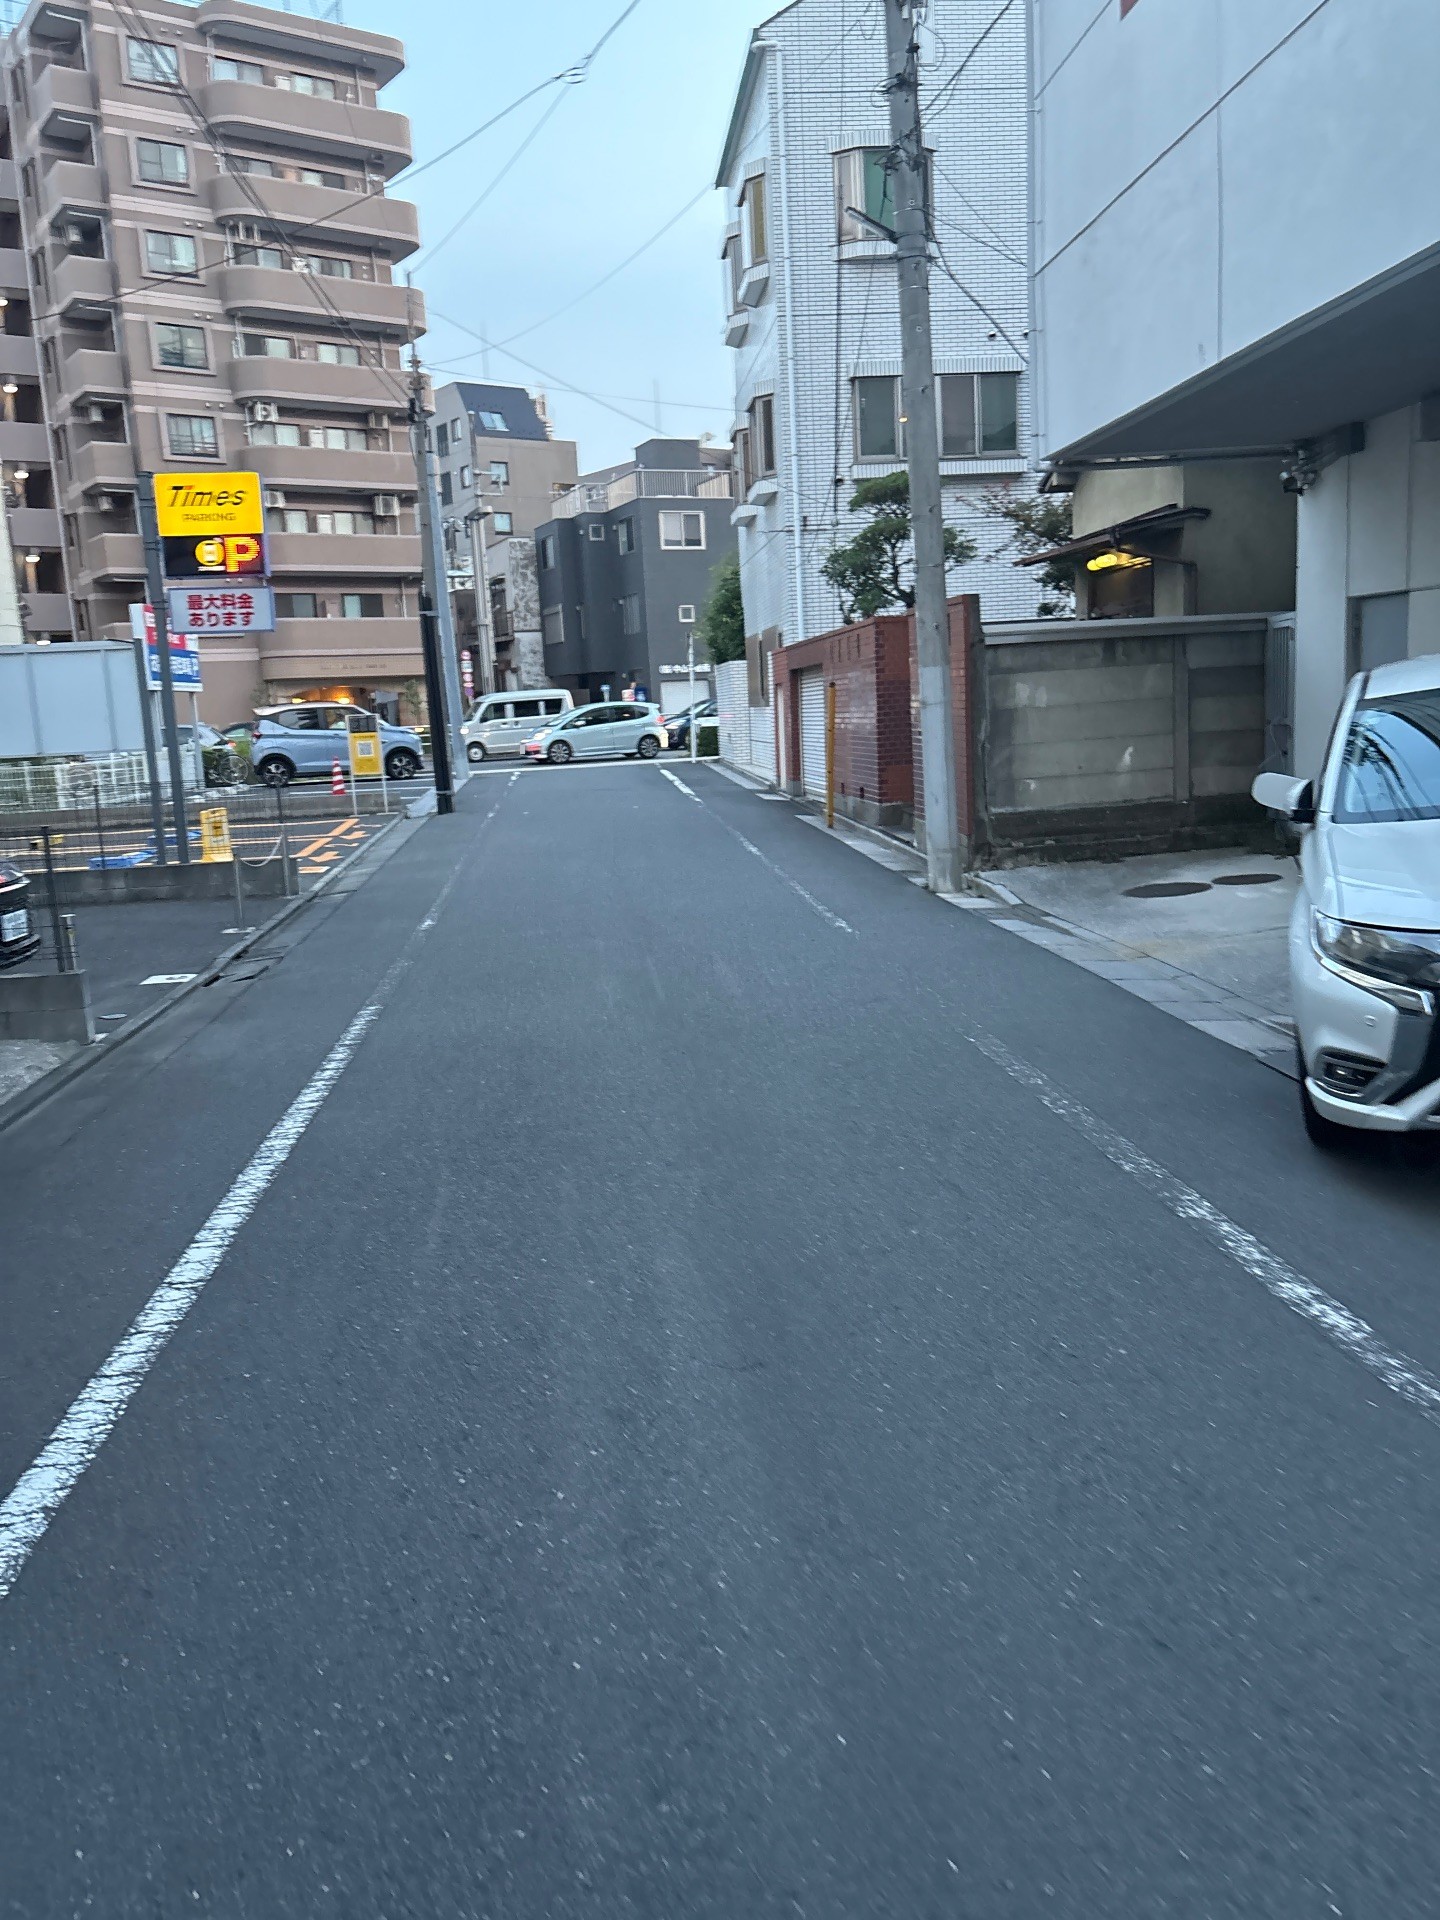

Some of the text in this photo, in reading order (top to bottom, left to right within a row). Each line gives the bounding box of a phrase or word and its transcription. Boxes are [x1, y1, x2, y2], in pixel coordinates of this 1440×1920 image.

[167, 485, 246, 507] Times
[187, 593, 254, 610] 最大料金
[188, 611, 255, 627] あります
